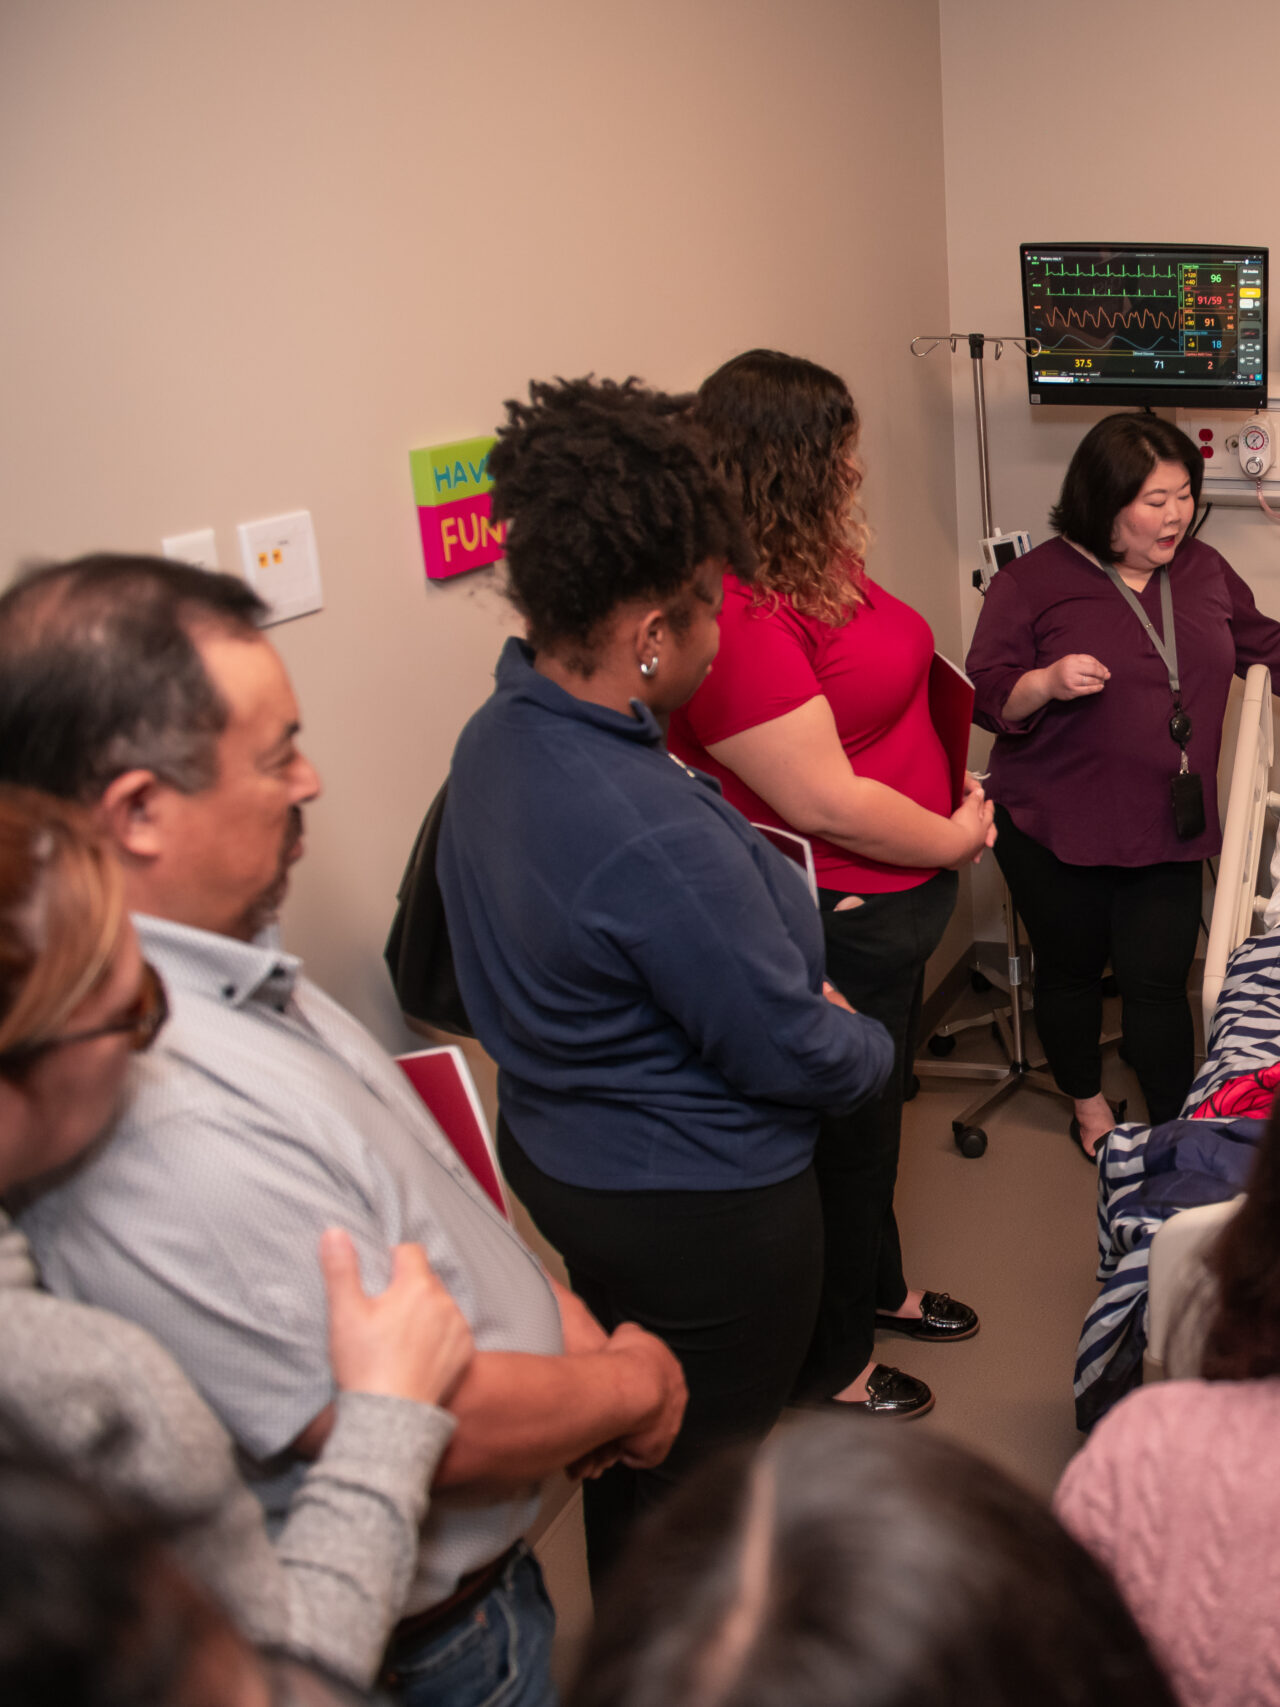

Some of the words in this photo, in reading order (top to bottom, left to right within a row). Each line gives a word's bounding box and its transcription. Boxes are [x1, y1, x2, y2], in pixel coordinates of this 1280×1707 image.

[1210, 274, 1222, 283] 96
[1197, 296, 1223, 305] 91/59
[1204, 318, 1215, 327] 91
[1211, 340, 1222, 349] 18
[1074, 359, 1092, 368] 37.5
[1153, 360, 1164, 369] 71
[1207, 361, 1213, 370] 2
[440, 512, 502, 562] FUN
